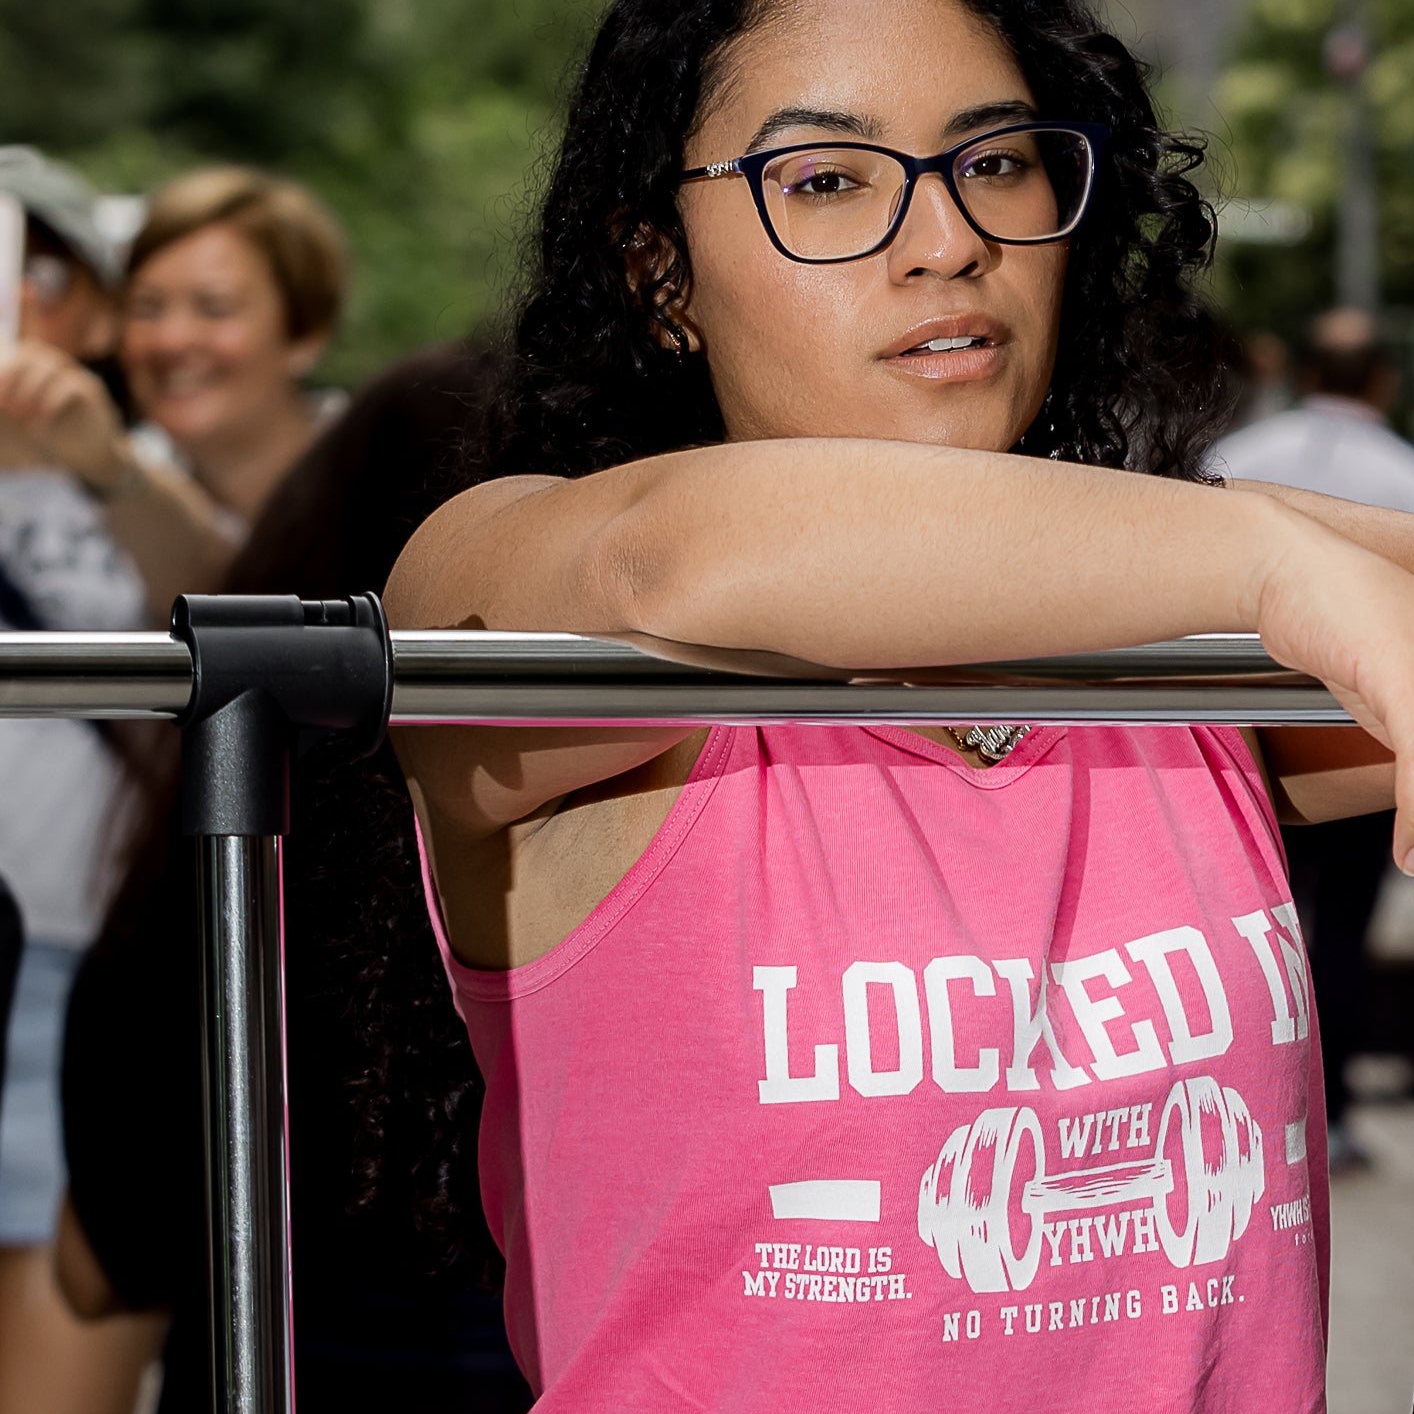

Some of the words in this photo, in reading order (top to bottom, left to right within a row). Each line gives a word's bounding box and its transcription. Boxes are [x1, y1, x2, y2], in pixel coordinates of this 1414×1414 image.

[753, 925, 1234, 1105] LOCKED
[1057, 1102, 1153, 1159] WITH
[755, 1242, 801, 1270] THE
[803, 1244, 861, 1274] LORD
[867, 1246, 893, 1274] IS
[1042, 1206, 1160, 1267] YHWH
[742, 1270, 781, 1298] MY
[784, 1272, 913, 1303] STRENGTH.
[942, 1309, 981, 1342] NO
[1000, 1289, 1142, 1336] TURNING
[1160, 1274, 1246, 1315] BACK.
